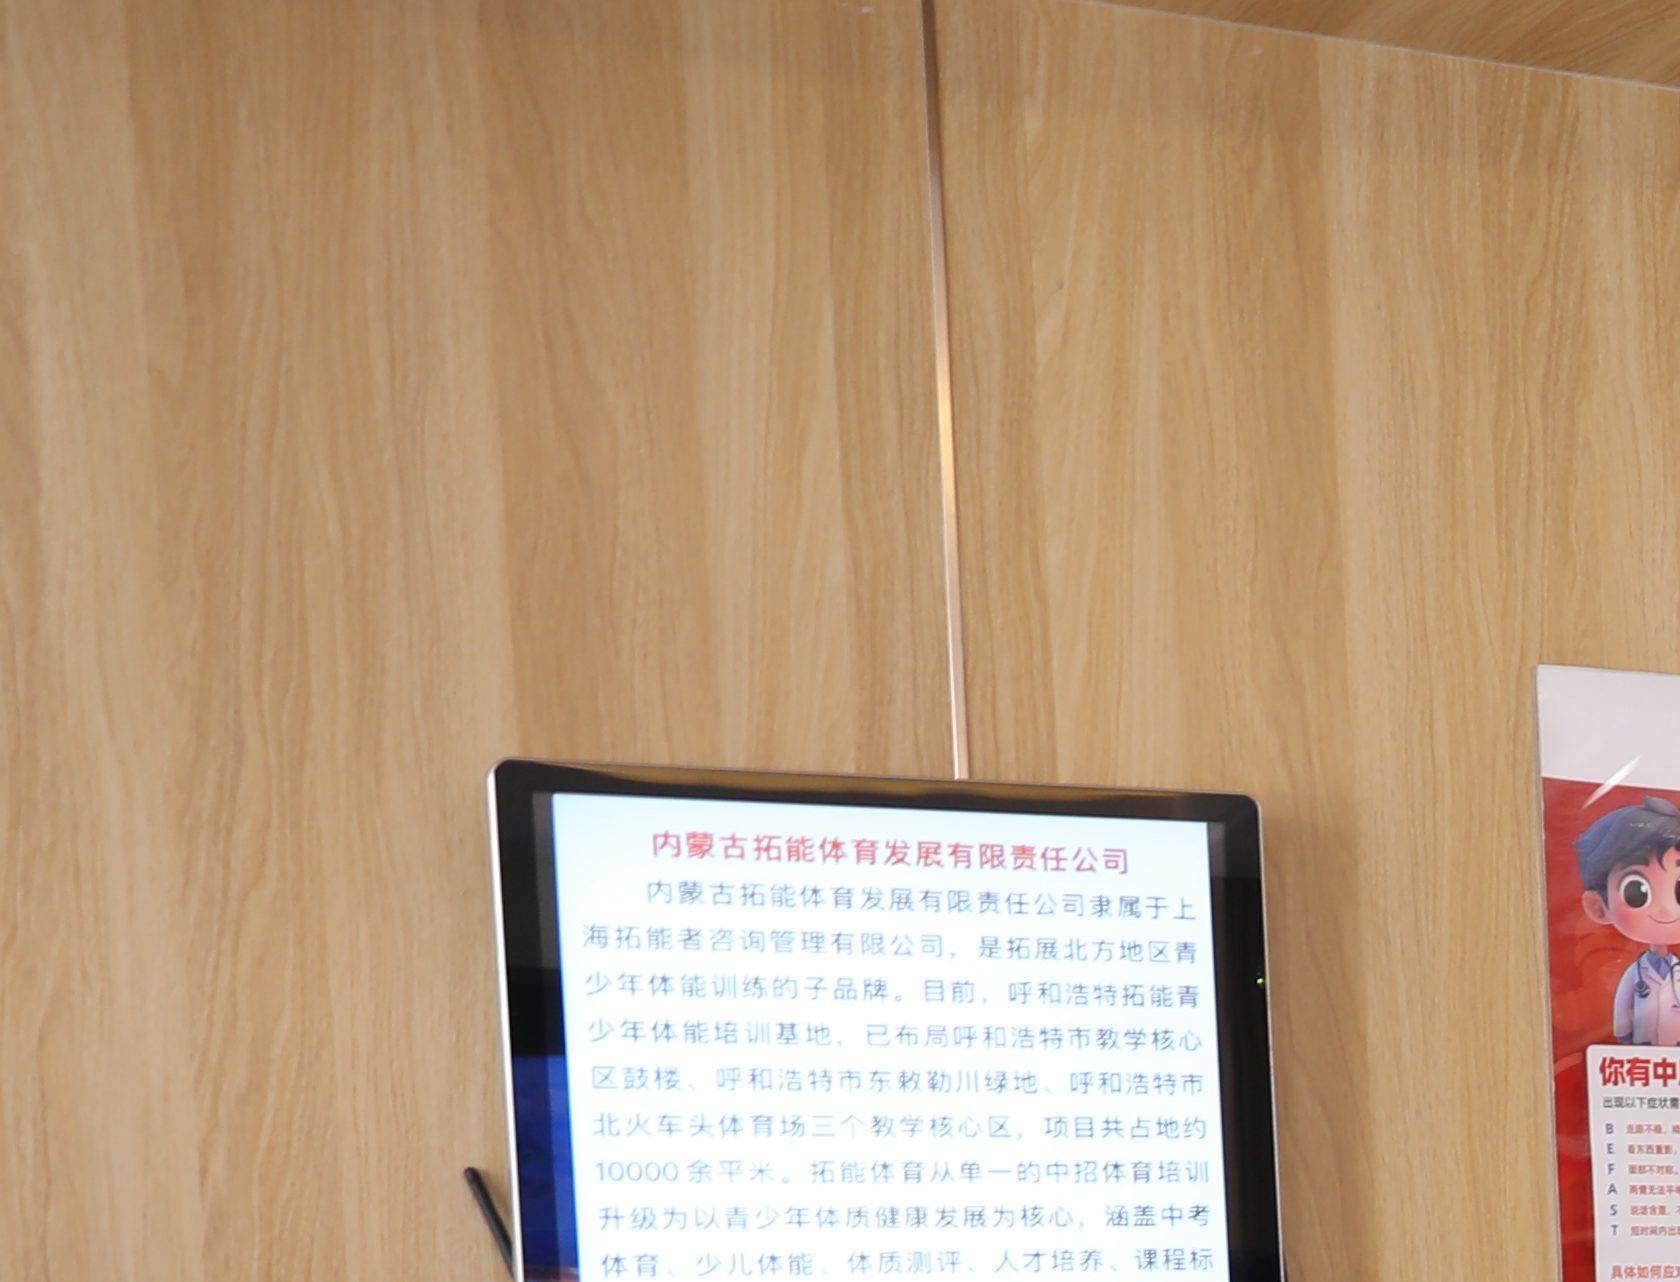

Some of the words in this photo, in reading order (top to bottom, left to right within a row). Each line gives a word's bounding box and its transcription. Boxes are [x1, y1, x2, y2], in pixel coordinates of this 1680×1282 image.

[651, 830, 1129, 875] 内蒙古拓能体育发展有限责任公司
[647, 879, 1197, 921] 内蒙古拓能体育发展有限责任公司隶属于上
[582, 923, 1197, 965] 海拓能者咨询管理有限公司，是拓展北方地区青
[1605, 1123, 1614, 1135] B
[1607, 1144, 1614, 1155] E
[1608, 1164, 1615, 1175] F
[1607, 1184, 1618, 1195] A
[1610, 1204, 1618, 1216] S
[1611, 1225, 1619, 1236] T
